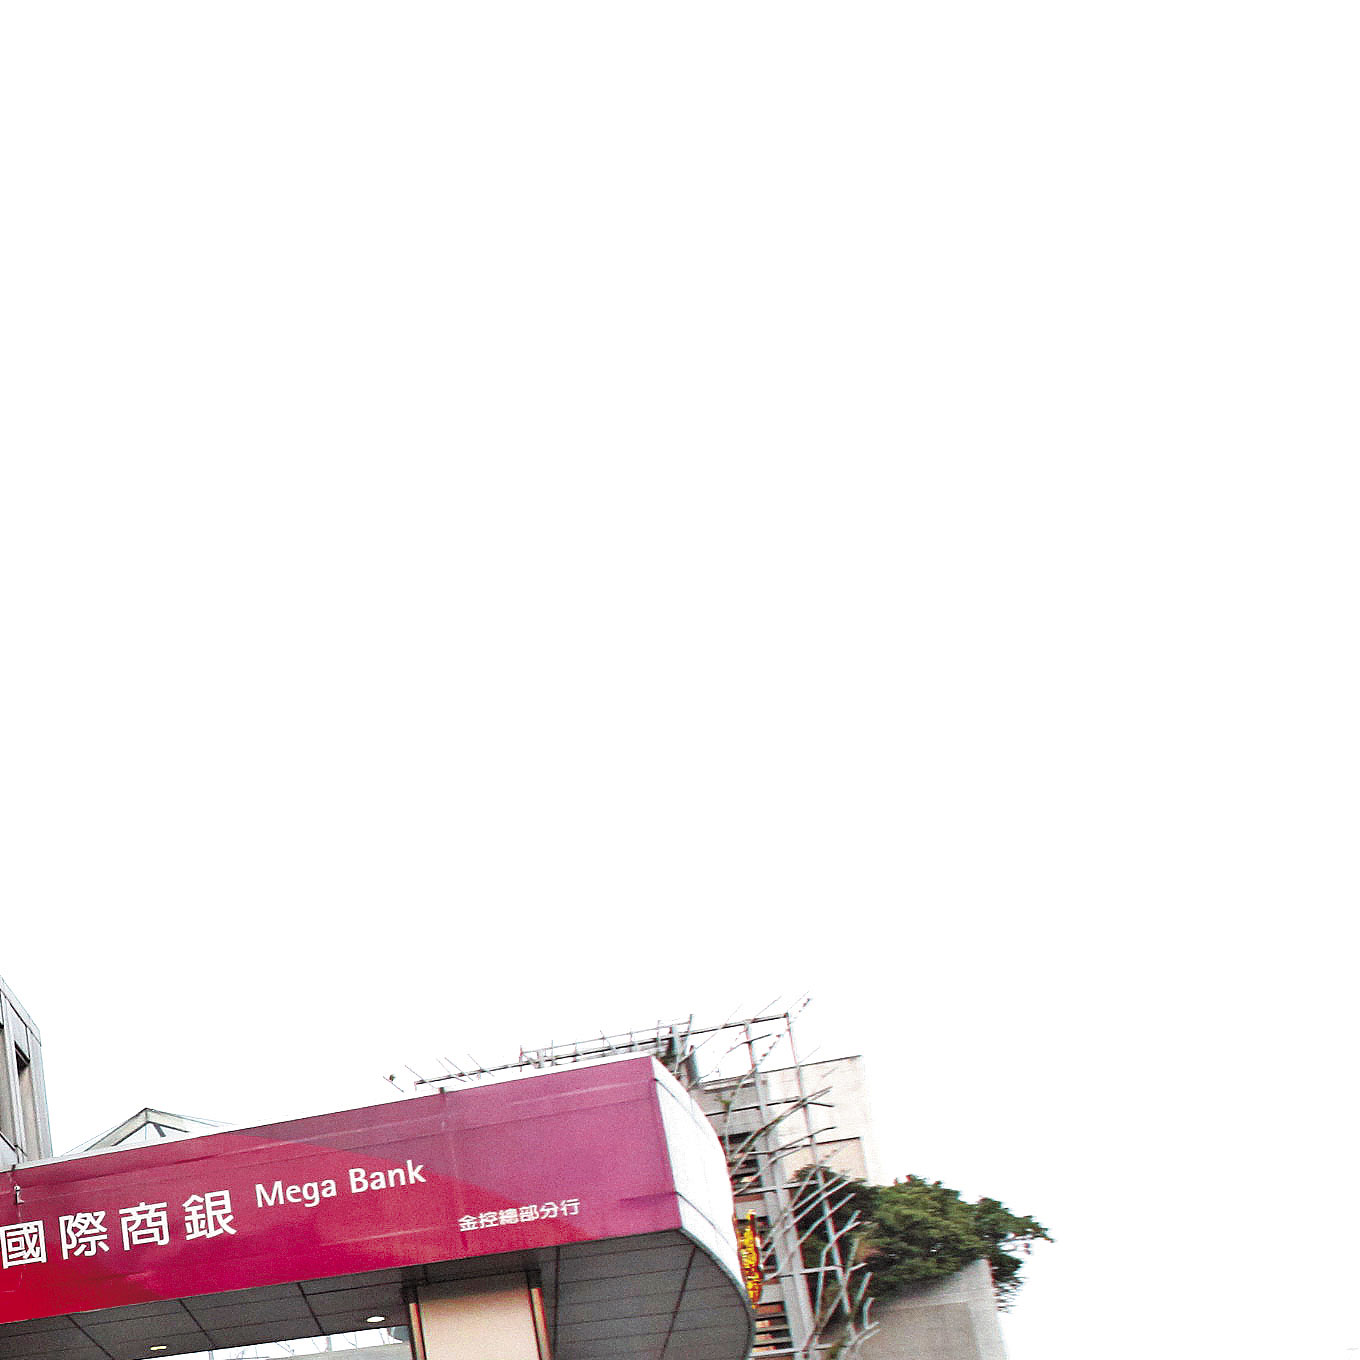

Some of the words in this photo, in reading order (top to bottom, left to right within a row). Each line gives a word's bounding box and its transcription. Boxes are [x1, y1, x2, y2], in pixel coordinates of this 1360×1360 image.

[255, 1179, 337, 1208] Mega
[348, 1159, 427, 1194] Bank
[458, 1198, 581, 1232] 金控總部分行
